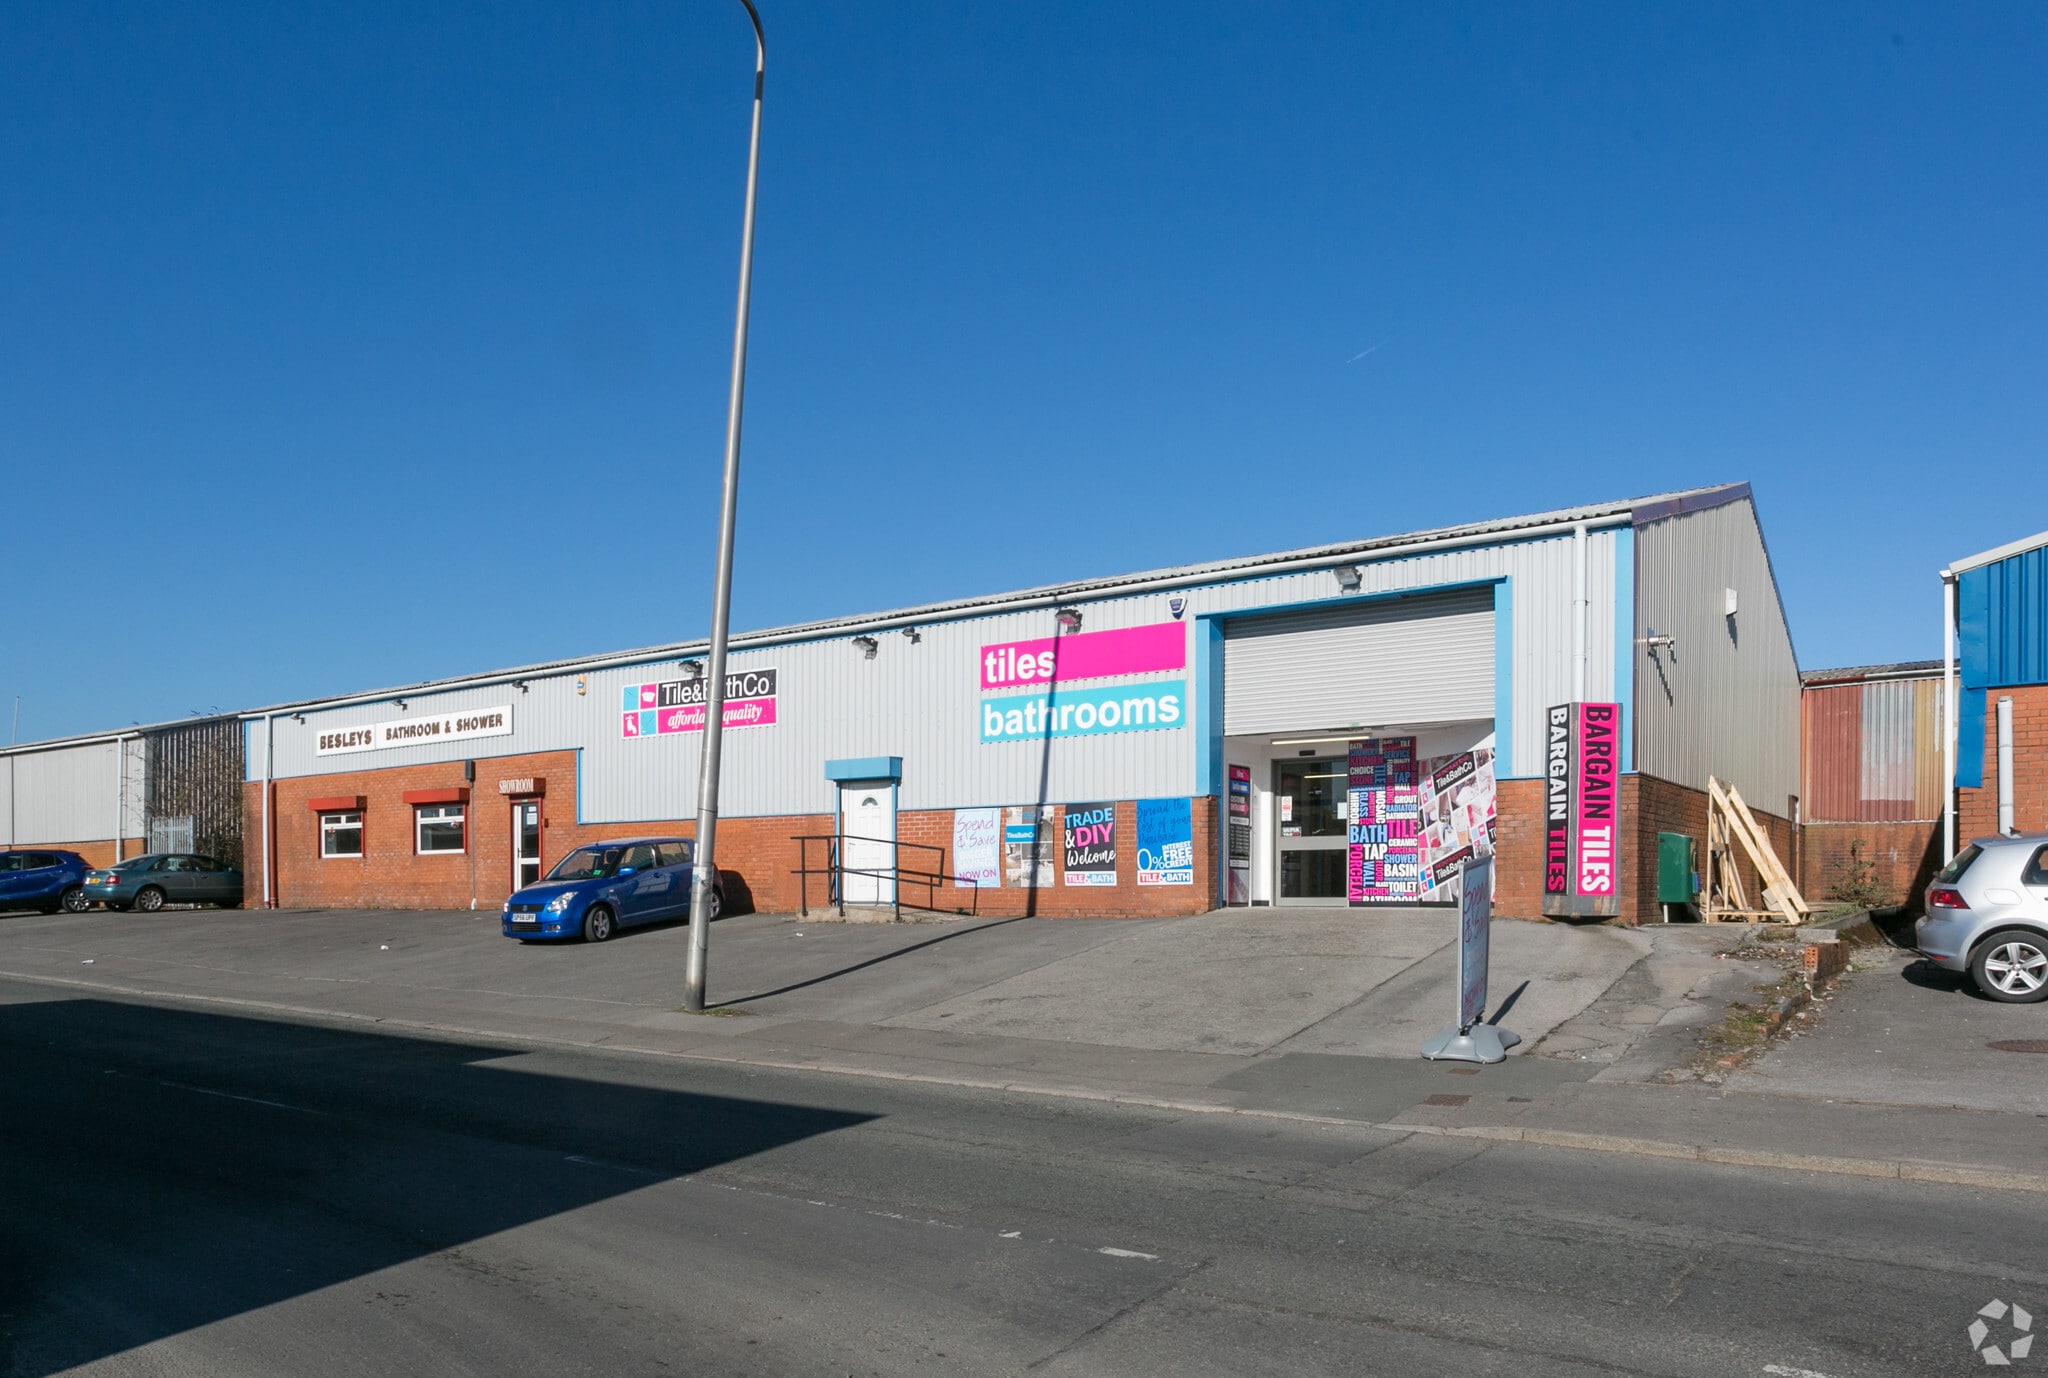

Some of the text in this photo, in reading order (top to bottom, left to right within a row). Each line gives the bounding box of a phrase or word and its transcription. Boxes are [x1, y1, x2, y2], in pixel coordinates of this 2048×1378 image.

[985, 648, 1056, 683] tiles
[662, 673, 770, 703] Tile&thCo
[723, 704, 763, 724] quality
[984, 695, 1180, 737] bathrooms
[320, 713, 503, 750] BESLEYS BATHROOM & SHOWER
[1350, 766, 1374, 775] CHOICE
[1394, 771, 1411, 783] TAP
[499, 778, 534, 794] SHOWROOM
[1360, 792, 1369, 818] GLASS
[1394, 795, 1418, 804] GROUT
[1548, 707, 1568, 892] BARGAIN TILES
[1581, 706, 1613, 892] BARGAIN TILES
[1350, 792, 1359, 825] MIRROR
[1376, 791, 1386, 824] MOSAIC
[1386, 804, 1417, 812] RADIATOR
[956, 811, 994, 839] Spend
[1064, 807, 1114, 828] TRADE
[1065, 822, 1114, 849] & DIY
[1350, 825, 1388, 843] BATH
[1387, 820, 1418, 838] TILE
[969, 832, 996, 848] Save
[1162, 841, 1192, 851] INTEREST
[1388, 838, 1418, 847] CERAMIC
[1067, 846, 1117, 867] Welcome
[1163, 848, 1192, 861] FREE
[1363, 844, 1388, 860] TAP
[1384, 854, 1417, 864] SHOWER
[1164, 859, 1192, 869] CREDIT
[1384, 864, 1418, 877] BASIN
[959, 868, 997, 880] NOW ON
[1067, 874, 1085, 884] TILE
[1092, 873, 1114, 884] BATH
[1140, 873, 1160, 883] TILE
[1166, 872, 1190, 882] BATH
[1363, 861, 1375, 888] WALL
[1363, 887, 1389, 896] KITCHEN
[1388, 882, 1418, 893] TOILET
